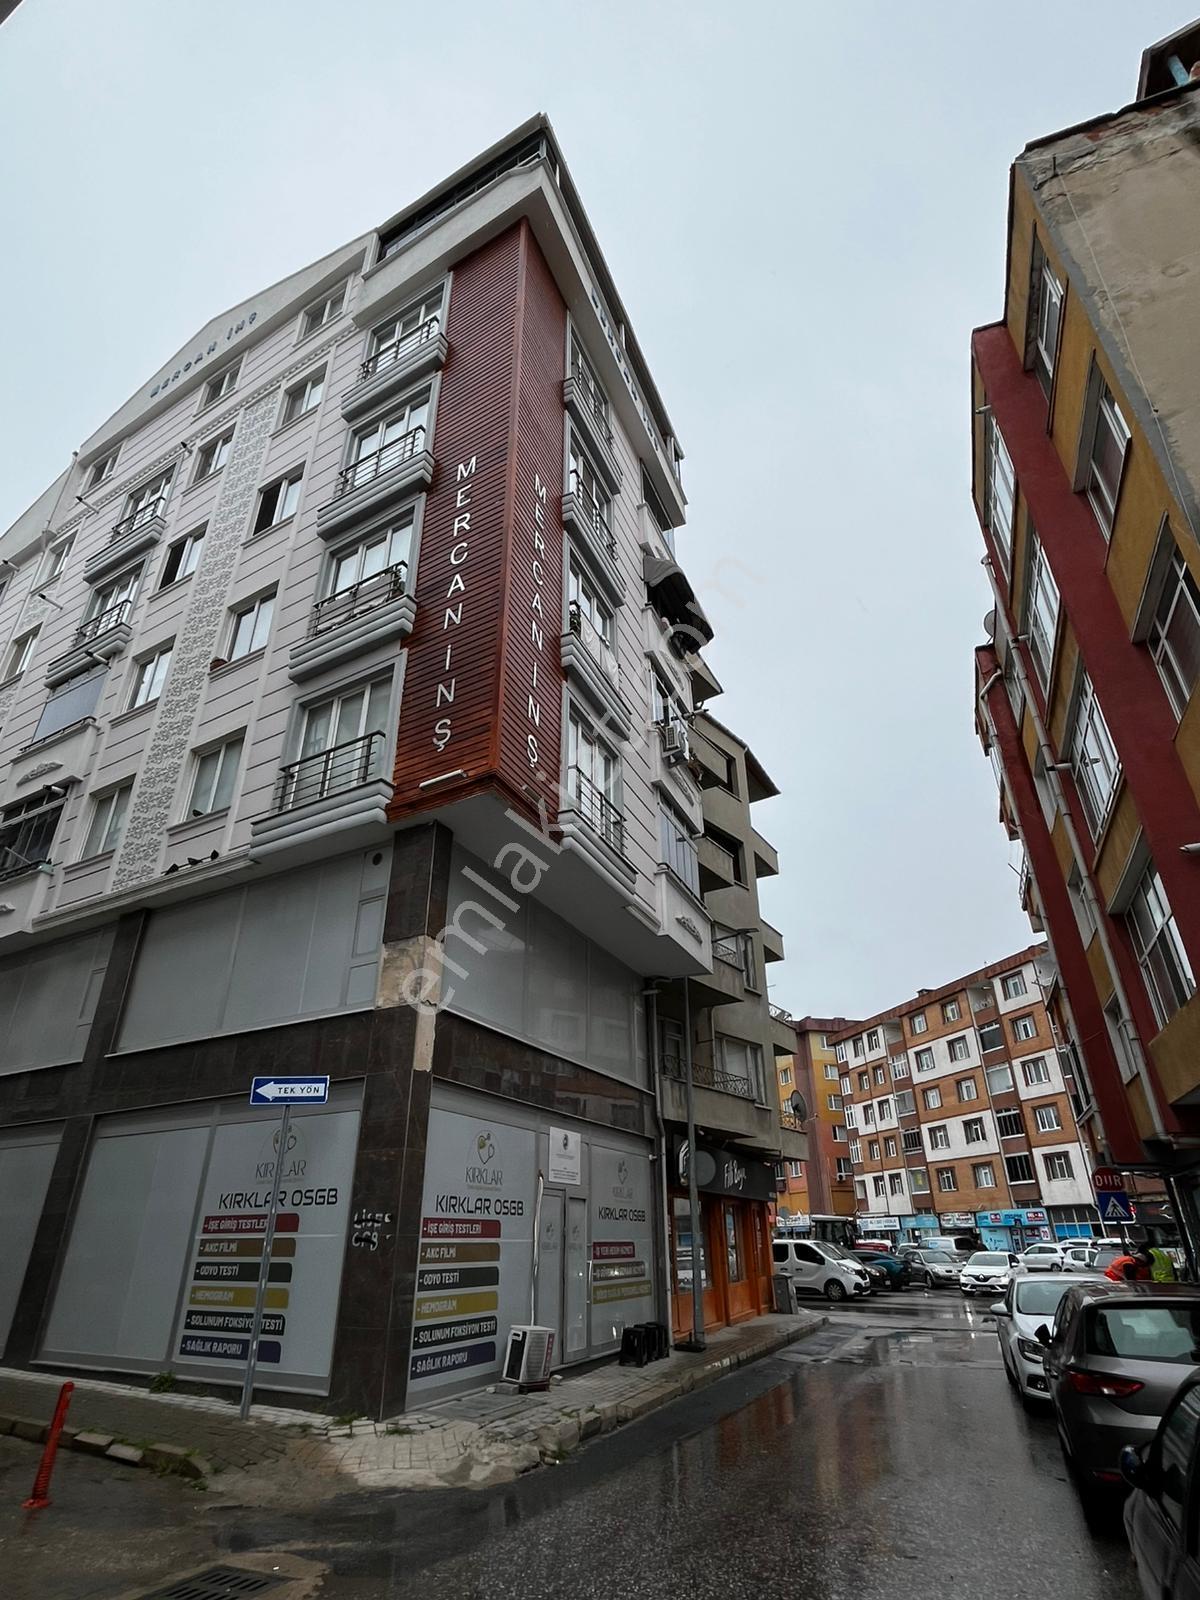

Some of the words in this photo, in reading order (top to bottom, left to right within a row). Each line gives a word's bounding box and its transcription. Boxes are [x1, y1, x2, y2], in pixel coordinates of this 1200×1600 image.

[278, 1087, 295, 1095] TEK
[299, 1085, 320, 1094] YÖN
[291, 1188, 338, 1207] OSGB
[435, 1193, 492, 1215] KIRKLAR
[493, 1198, 525, 1217] OSGB
[598, 1206, 627, 1221] KIRKLAR
[190, 1314, 225, 1327] SOLUNUM
[419, 1327, 451, 1343] SOLUNUM
[185, 1339, 212, 1352] SAĞLIK
[211, 1342, 243, 1355] RAPORU
[416, 1356, 442, 1373] SAĞLIK
[441, 1351, 468, 1367] RAPORU
